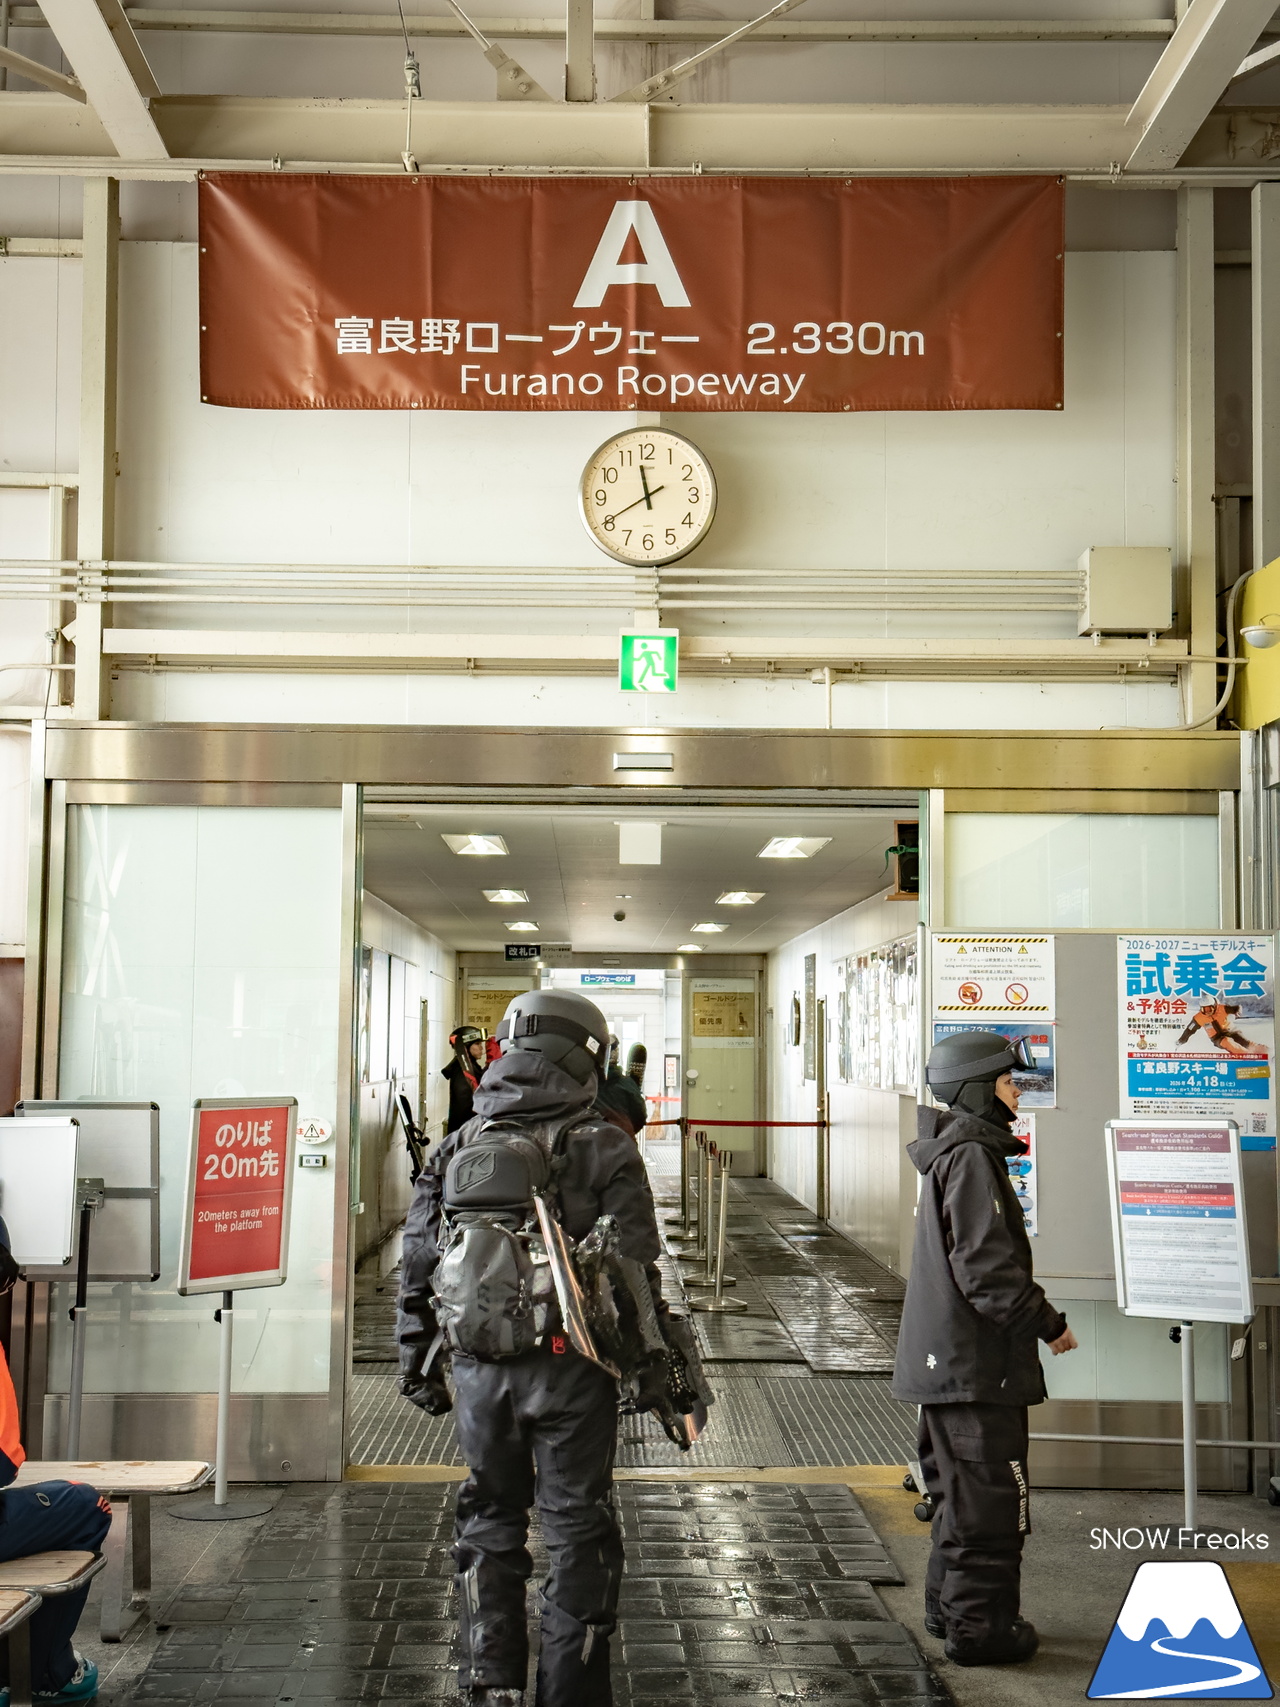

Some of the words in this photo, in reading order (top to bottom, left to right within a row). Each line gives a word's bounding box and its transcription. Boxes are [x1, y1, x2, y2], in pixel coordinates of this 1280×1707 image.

[572, 200, 691, 308] A
[334, 317, 700, 356] 富良野ロープウェー
[746, 322, 925, 356] 2.330m
[459, 364, 605, 395] Furano
[616, 365, 806, 404] Ropeway
[619, 450, 632, 467] 11
[638, 443, 655, 460] 12
[668, 448, 672, 465] 1
[602, 467, 618, 484] 10
[681, 464, 693, 482] 2
[595, 489, 607, 506] 9
[688, 486, 700, 504] 3
[604, 514, 616, 532] 8
[681, 512, 694, 529] 4
[622, 529, 632, 546] 7
[642, 534, 654, 550] 6
[664, 528, 676, 545] 5
[508, 946, 537, 957] 改札口
[1126, 940, 1180, 950] 2026-2027
[1181, 940, 1266, 951] ニューモデルスキー
[1125, 952, 1268, 998] 試乗会
[1142, 1061, 1229, 1075] 富良野スキー場
[215, 1120, 273, 1148] のりば
[203, 1149, 280, 1181] 20m先
[198, 1209, 238, 1222] 20meters
[240, 1208, 260, 1220] away
[262, 1205, 279, 1216] from
[214, 1222, 228, 1233] the
[230, 1219, 263, 1233] platform
[1009, 1460, 1027, 1496] ARCTIC
[1018, 1498, 1027, 1532] QUEEN
